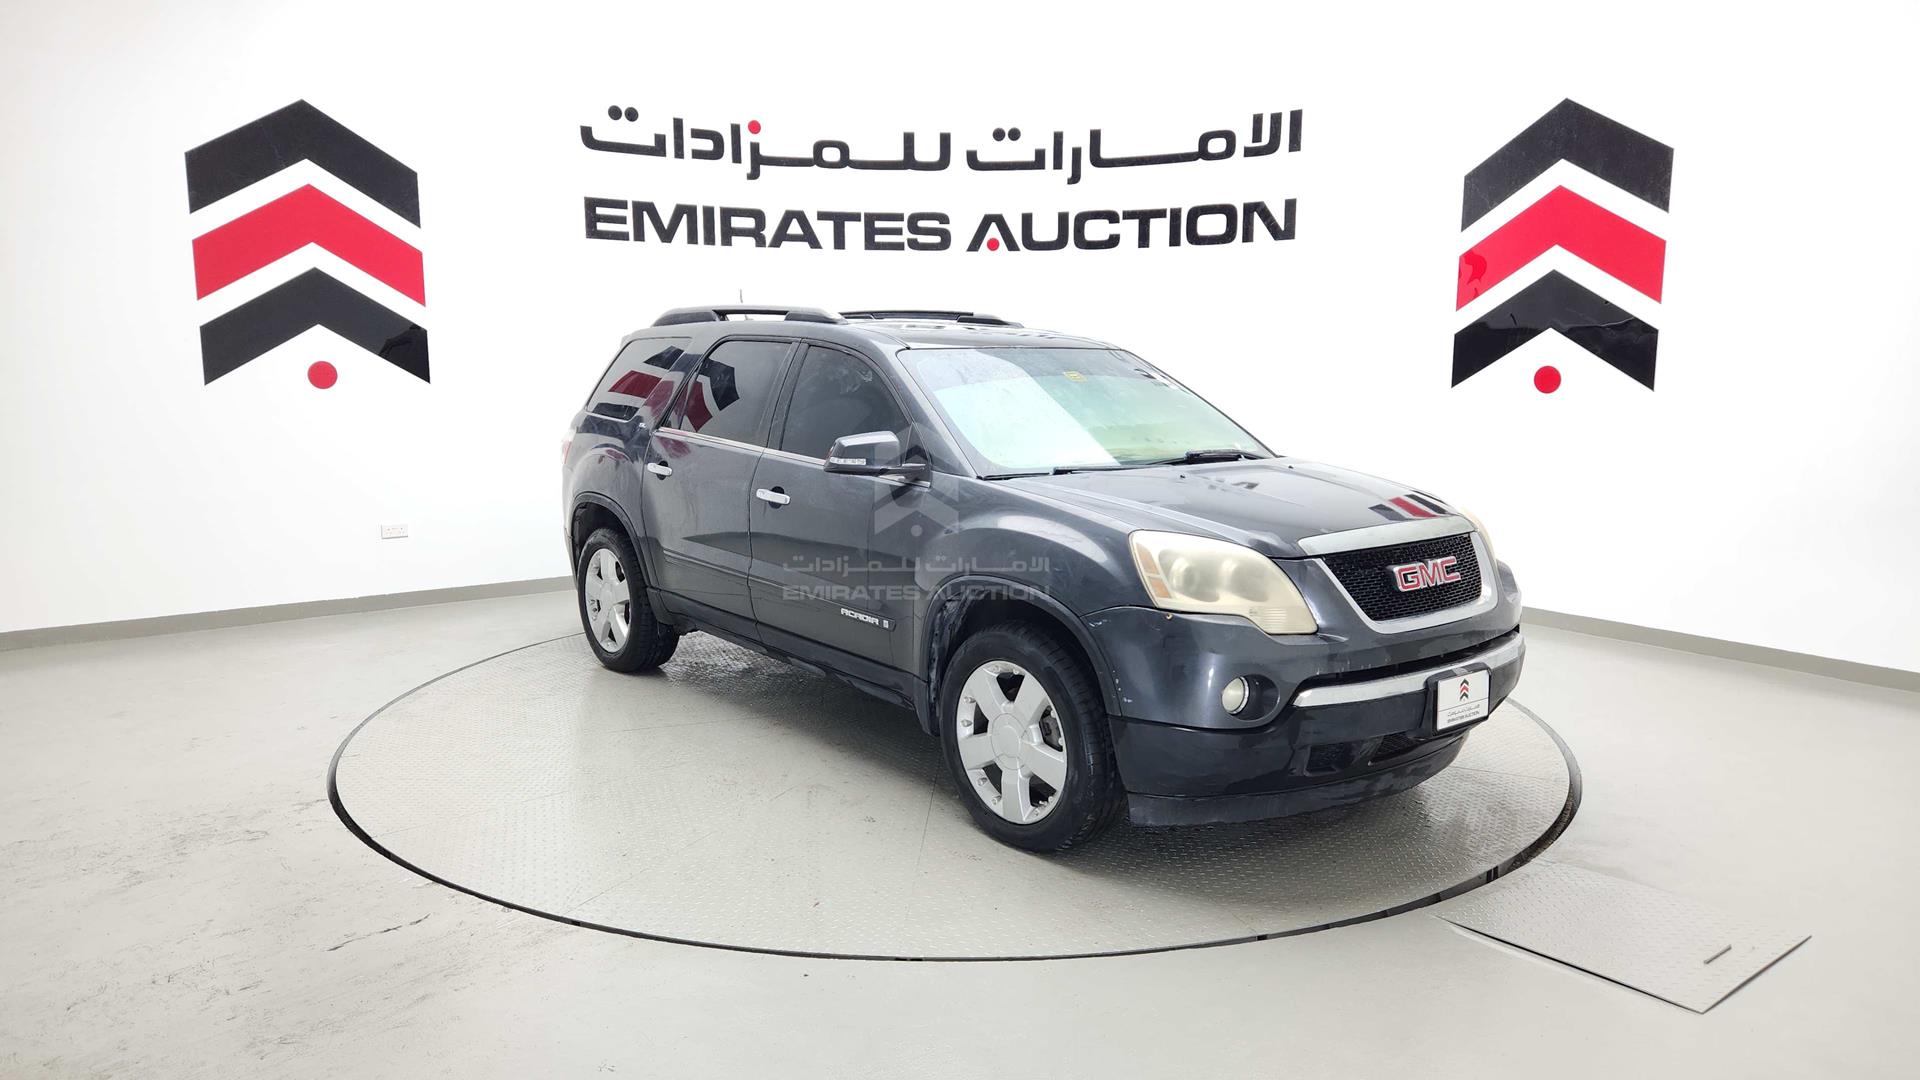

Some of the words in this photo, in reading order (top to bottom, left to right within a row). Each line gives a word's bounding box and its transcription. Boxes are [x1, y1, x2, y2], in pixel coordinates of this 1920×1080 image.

[580, 105, 951, 181] للمزادات
[584, 196, 952, 251] EMIRATES
[966, 198, 1297, 252] AUCTION
[1394, 556, 1461, 592] GMC
[840, 607, 879, 625] ACADIA
